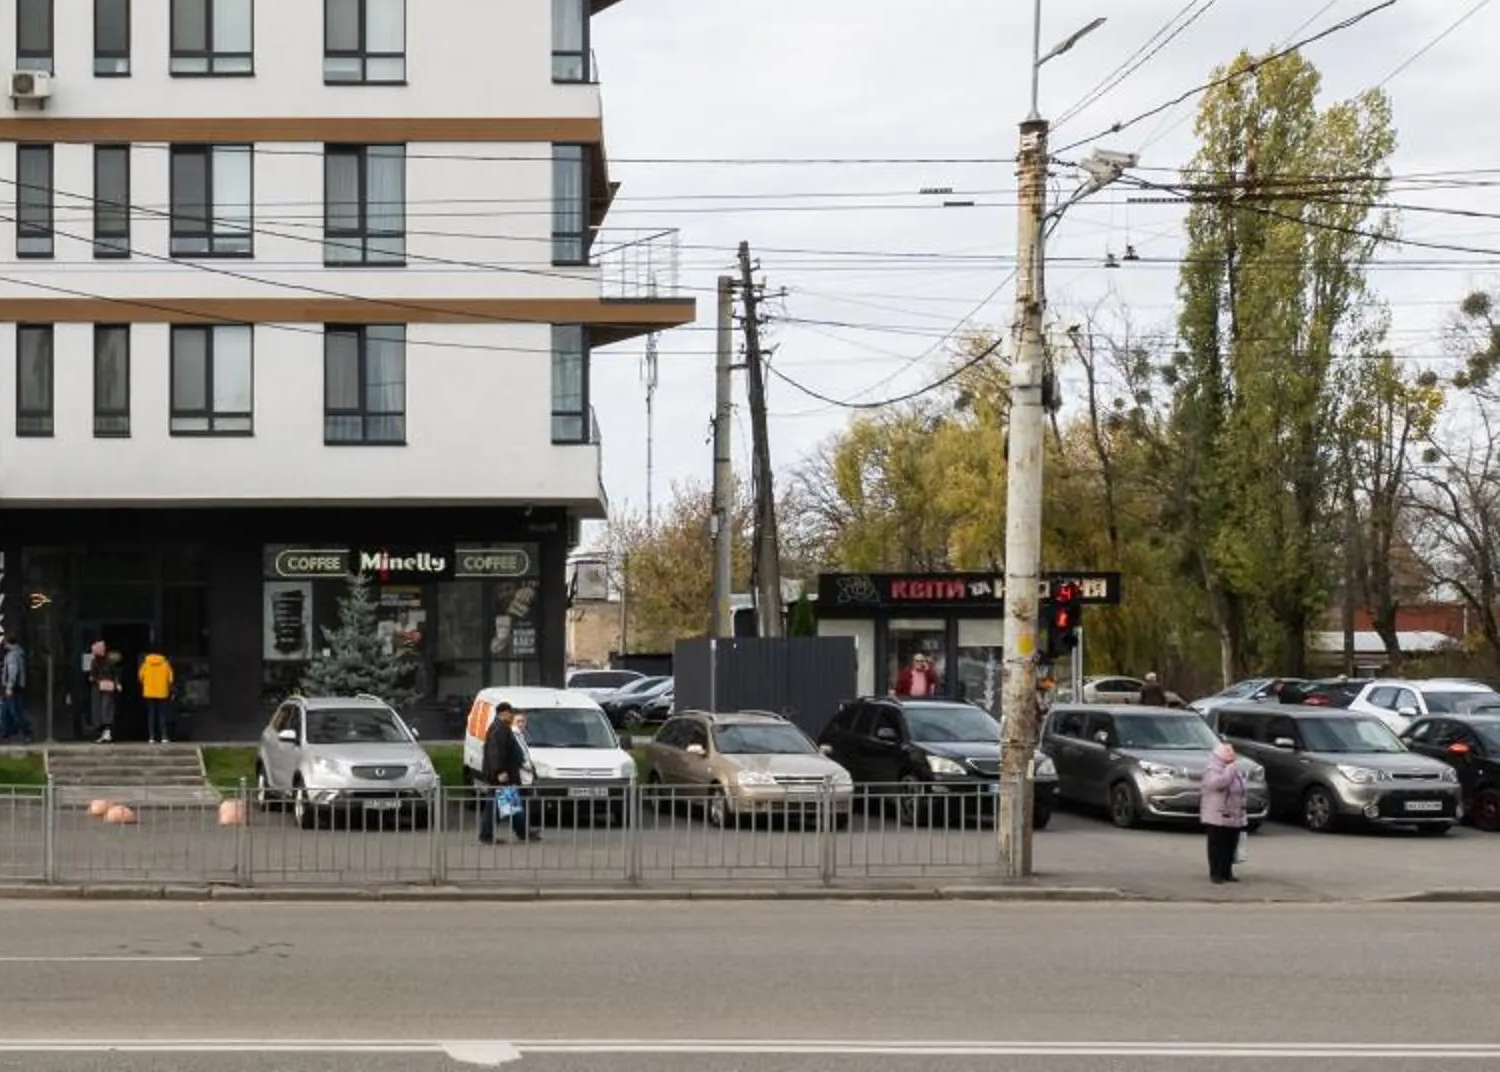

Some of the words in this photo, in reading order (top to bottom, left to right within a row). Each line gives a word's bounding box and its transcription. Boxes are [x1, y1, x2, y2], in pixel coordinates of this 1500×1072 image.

[287, 556, 341, 571] COFFEE
[360, 552, 446, 572] Minelly
[463, 556, 518, 571] COFFEE
